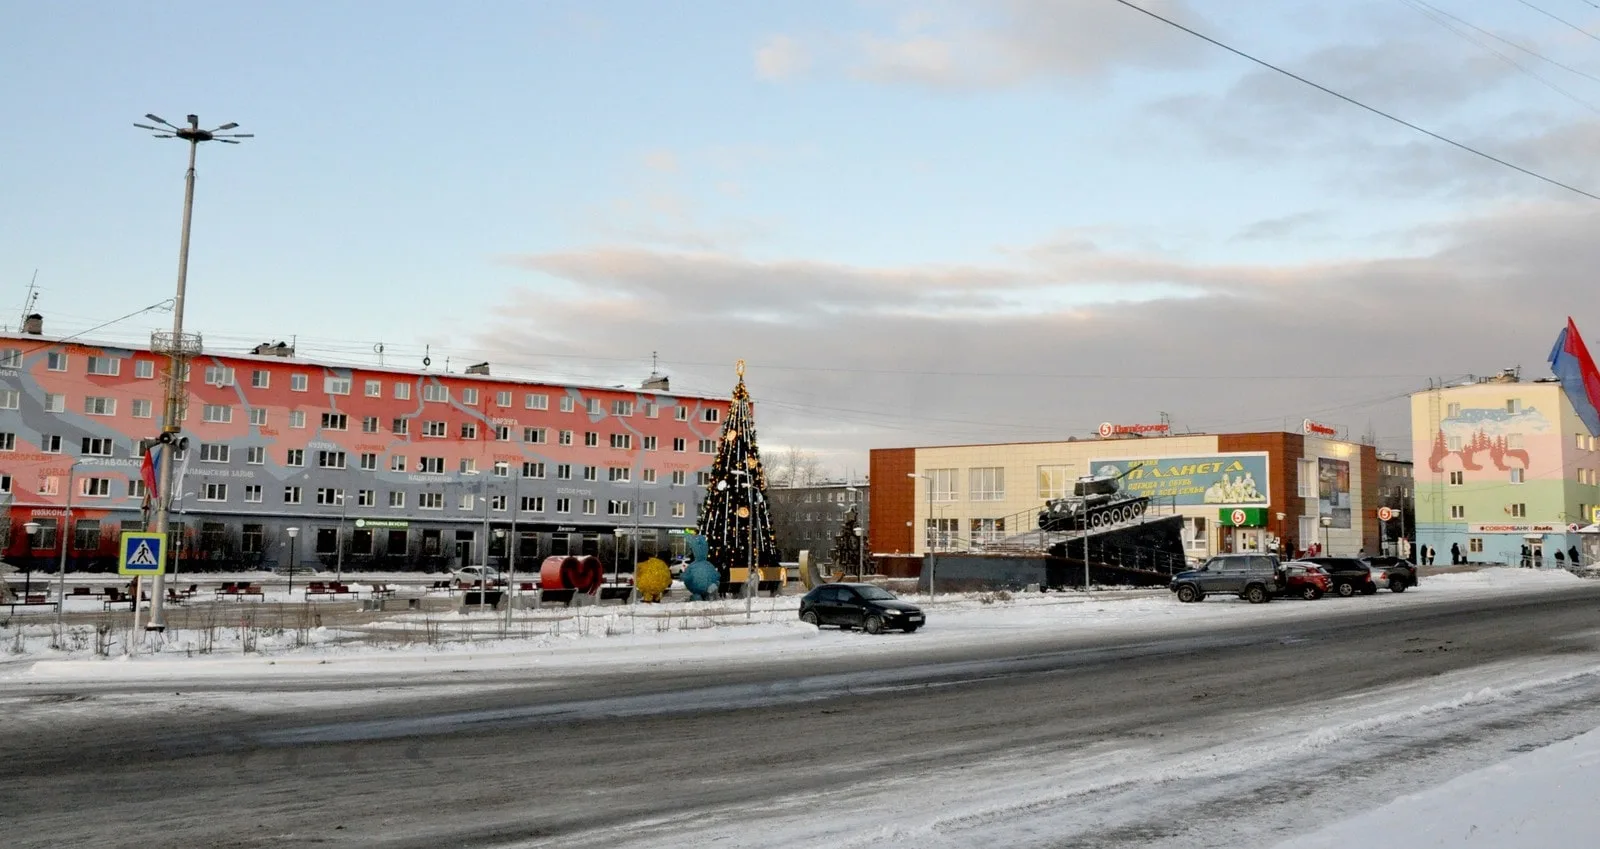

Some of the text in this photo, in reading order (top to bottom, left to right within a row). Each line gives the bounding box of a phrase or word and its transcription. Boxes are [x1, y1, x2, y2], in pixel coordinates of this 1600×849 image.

[1101, 422, 1111, 436] 5
[1128, 460, 1244, 480] ПЛАНЕТА
[1485, 524, 1530, 532] СОВКОМБАНК
